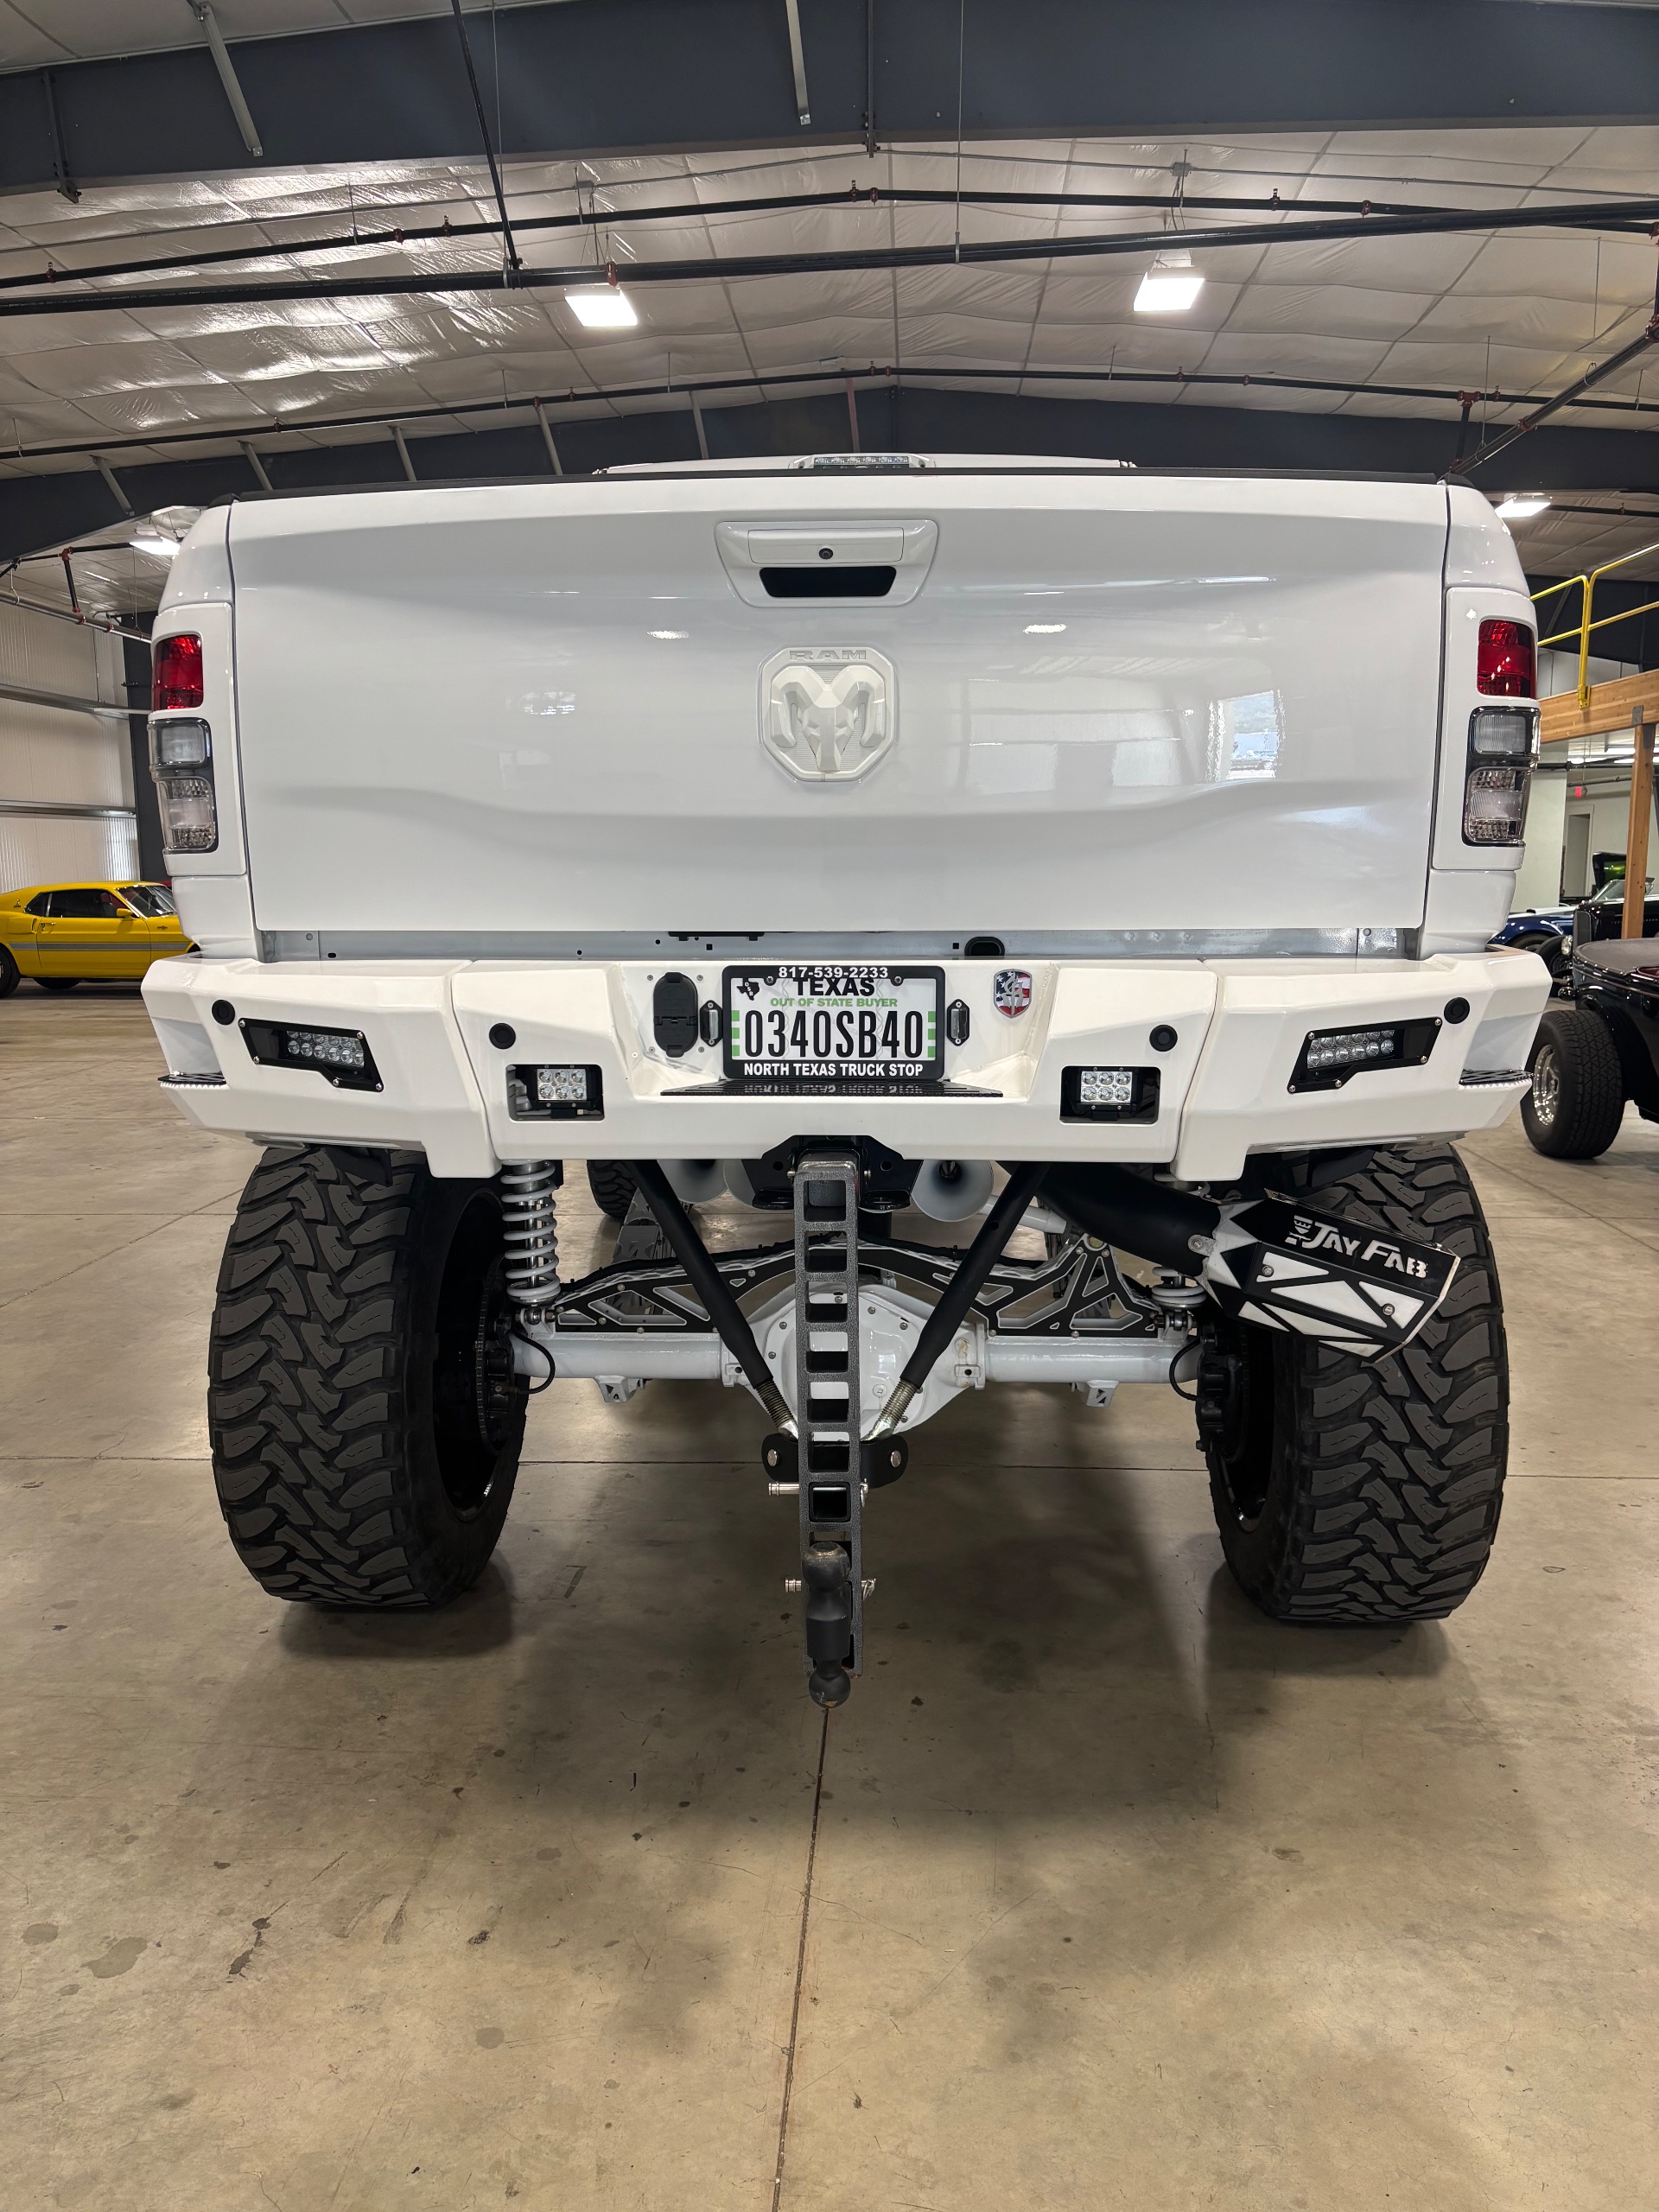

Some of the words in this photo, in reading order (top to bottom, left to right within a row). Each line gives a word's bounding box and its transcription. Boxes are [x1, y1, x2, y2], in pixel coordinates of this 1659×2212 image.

[789, 650, 867, 661] RAM
[778, 966, 889, 978] 817-539-2233
[792, 976, 875, 997] TEXAS
[770, 997, 795, 1007] OUT
[798, 997, 815, 1007] OF
[817, 997, 854, 1007] STATE
[856, 997, 898, 1007] BUYER
[743, 1062, 790, 1077] NORTH
[792, 1062, 836, 1077] TEXAS
[839, 1062, 886, 1077] TRUCK
[888, 1062, 924, 1077] STOP
[1301, 1221, 1362, 1256] JAY
[1361, 1239, 1428, 1279] FAB
